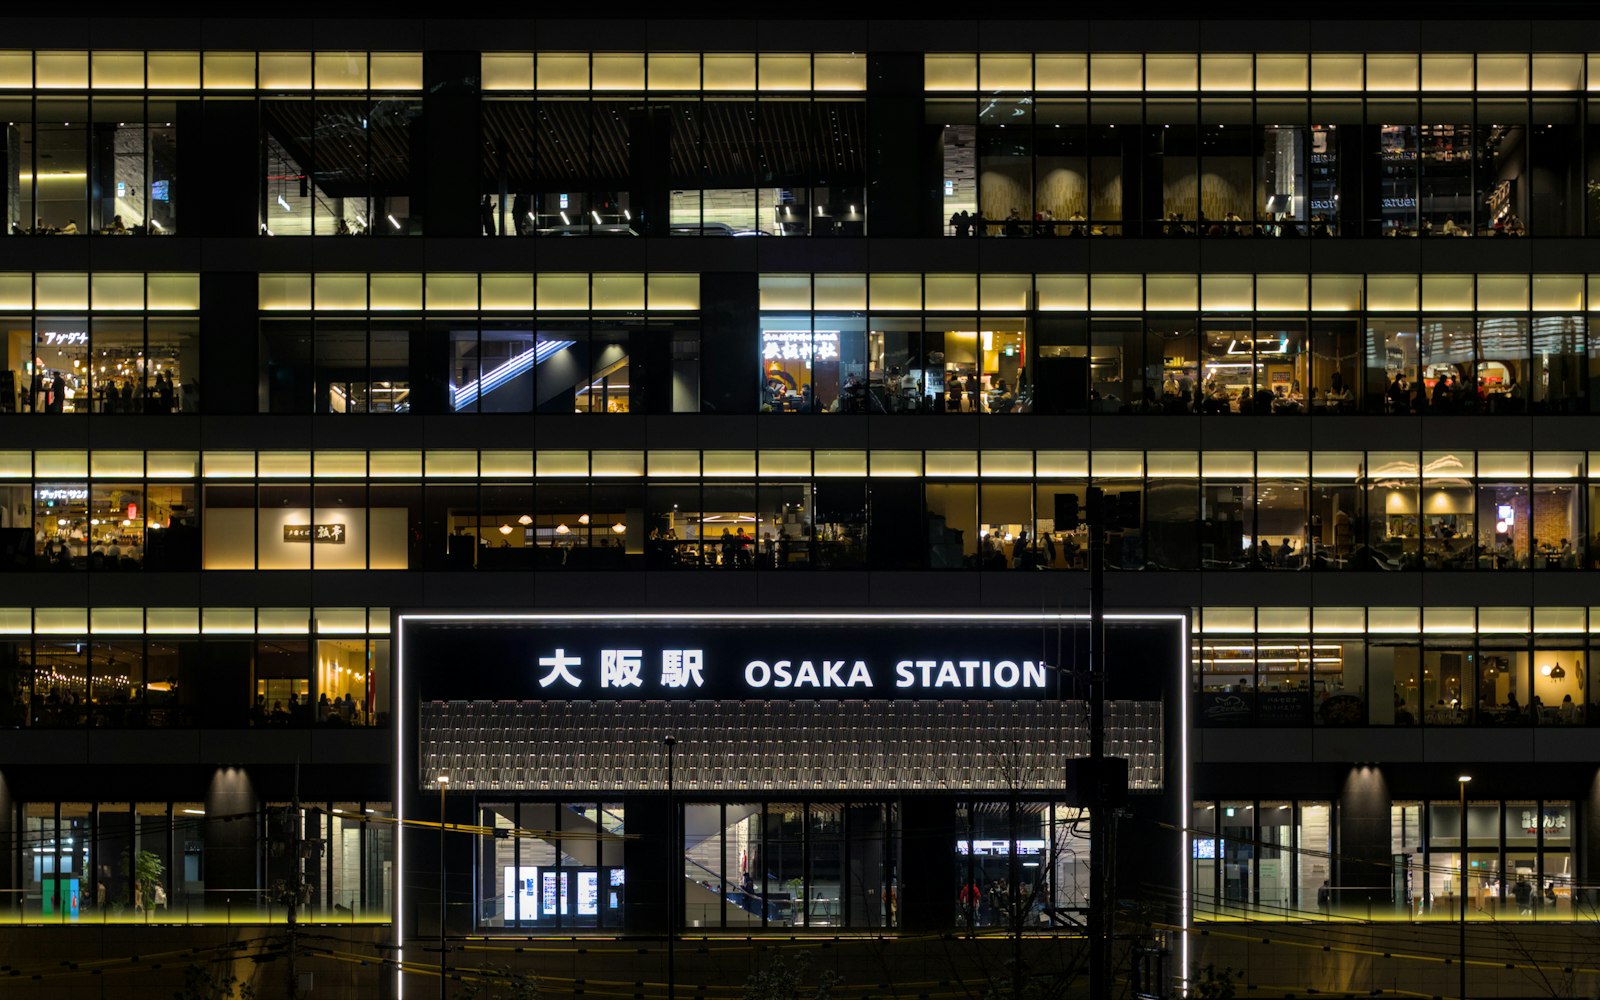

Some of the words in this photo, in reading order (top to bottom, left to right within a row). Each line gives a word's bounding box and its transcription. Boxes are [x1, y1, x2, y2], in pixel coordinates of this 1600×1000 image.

[538, 648, 705, 688] 大阪駅
[744, 660, 874, 688] OSAKA
[895, 660, 1047, 688] STATION
